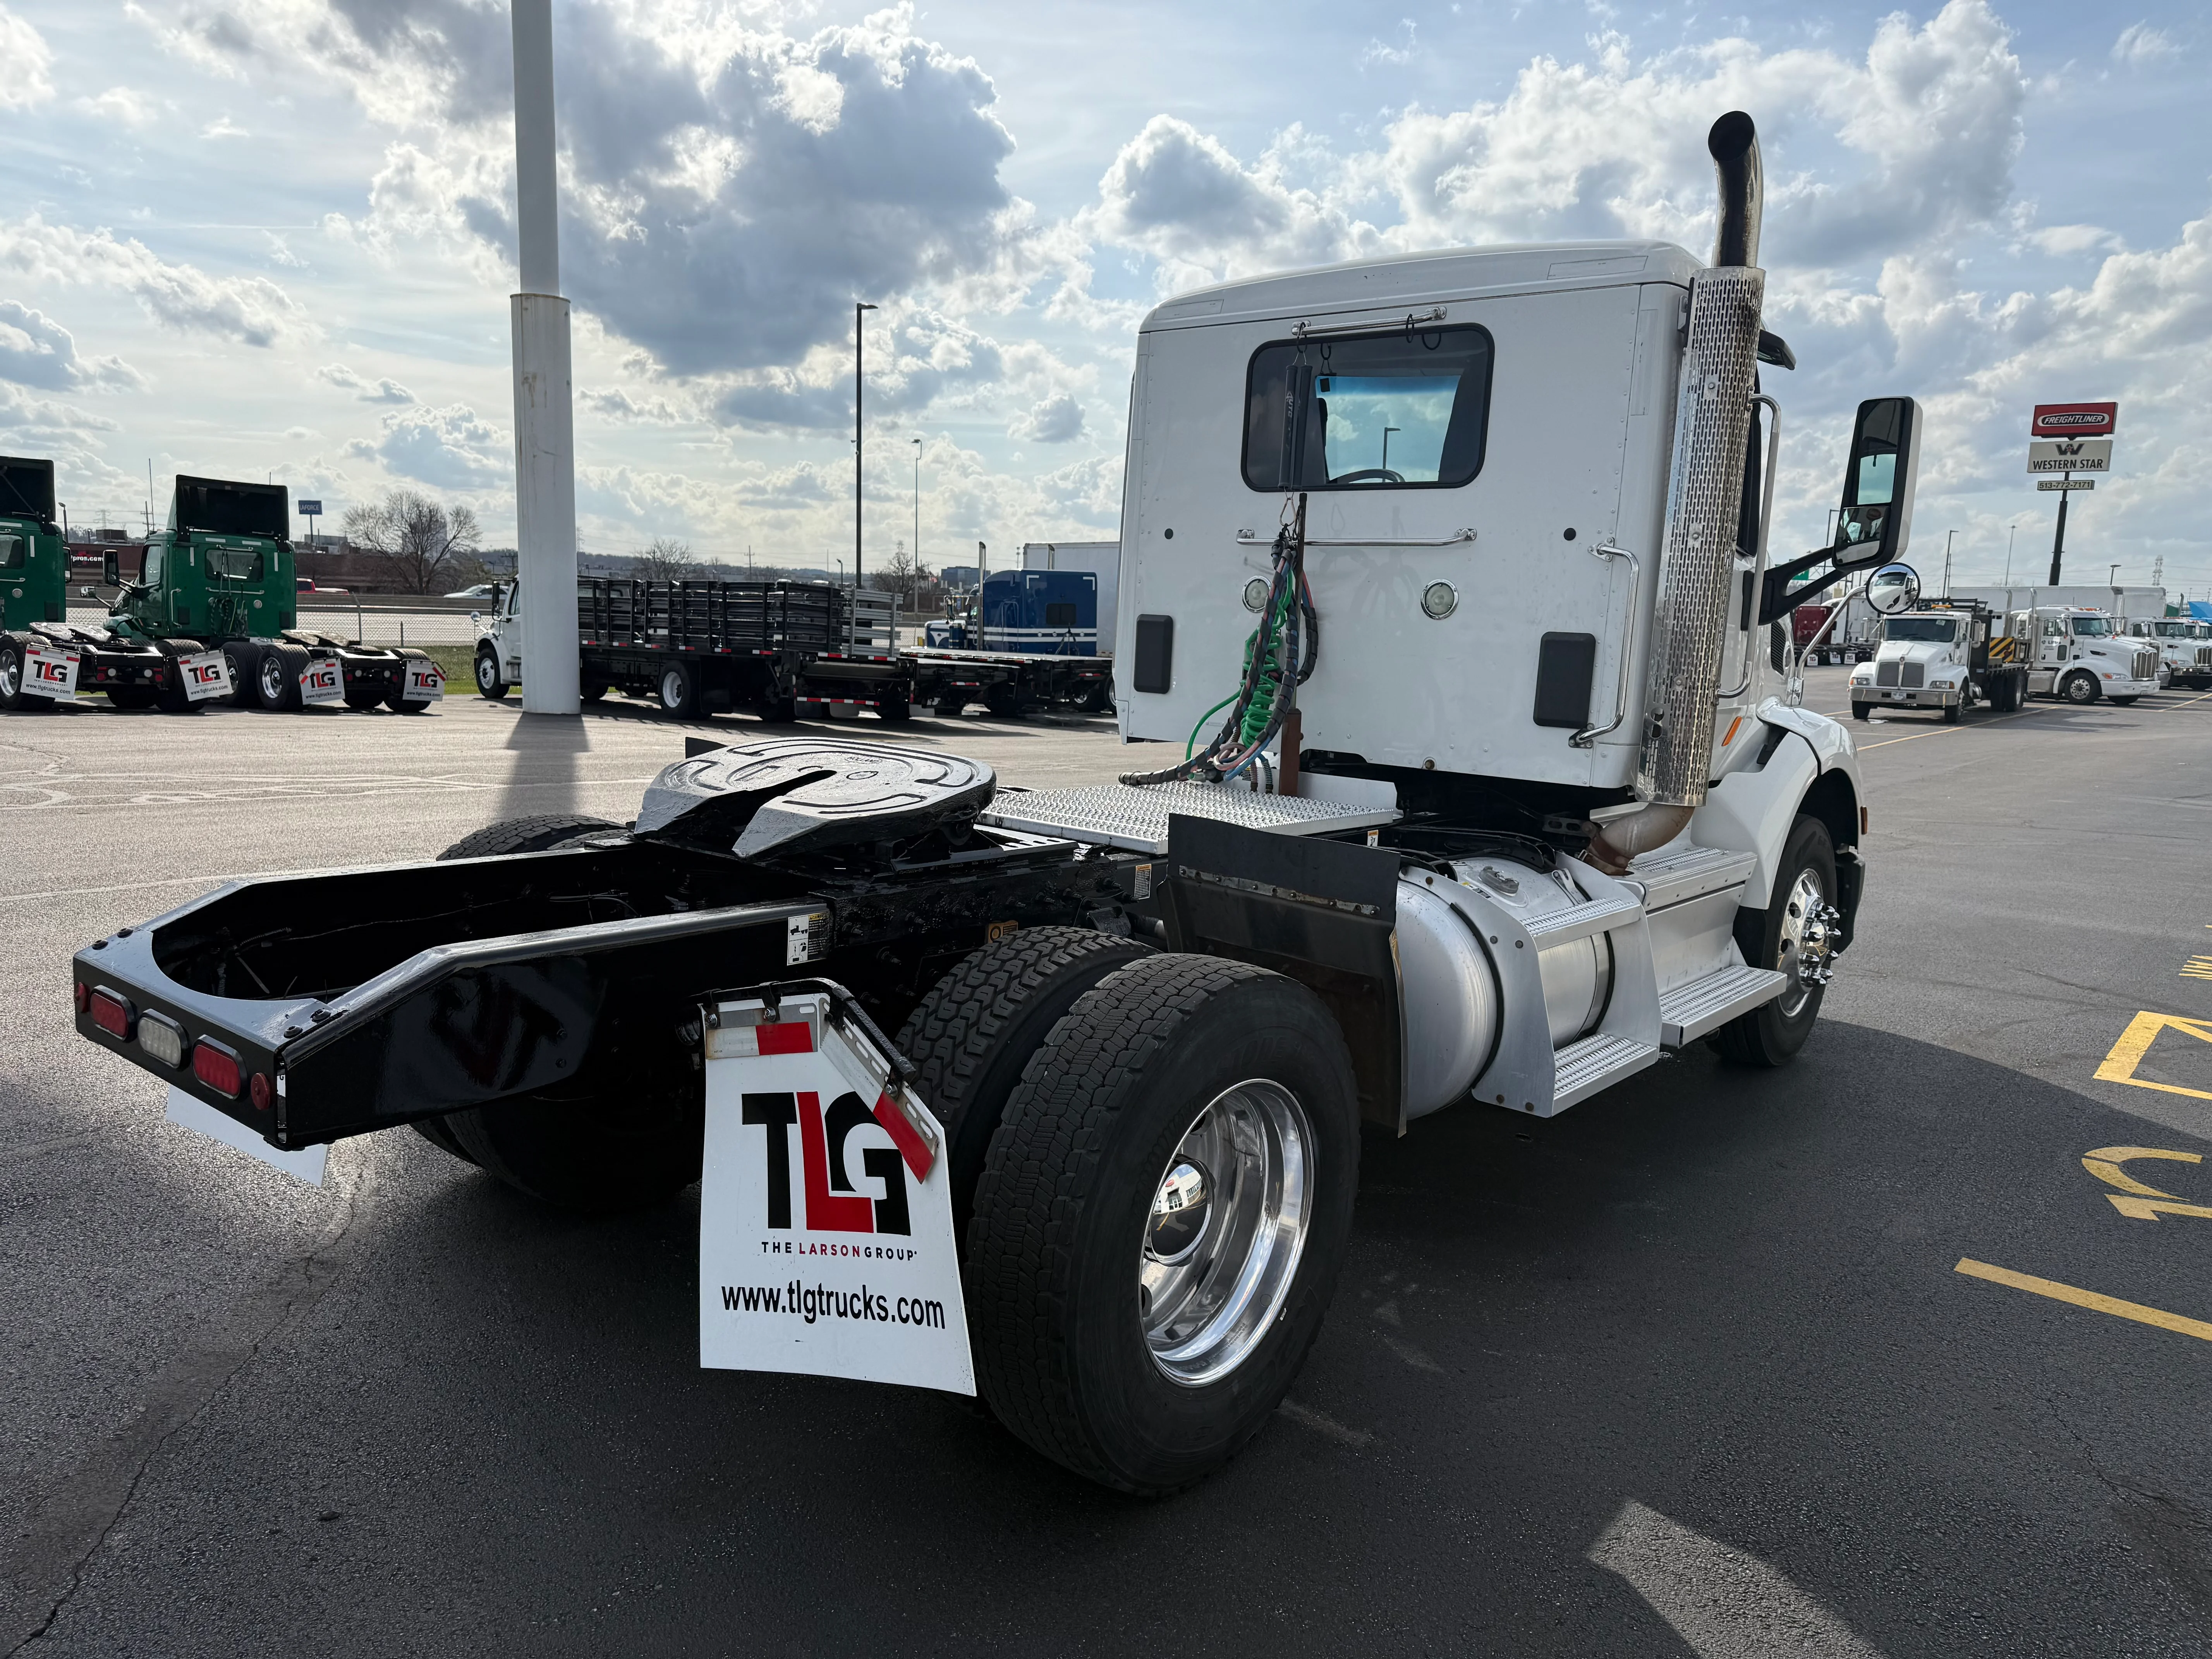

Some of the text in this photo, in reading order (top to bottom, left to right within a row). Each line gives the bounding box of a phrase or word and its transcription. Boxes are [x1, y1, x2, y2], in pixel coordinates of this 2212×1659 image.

[2044, 415, 2103, 424] FREIGHTLINER
[2033, 459, 2103, 470] WESTERN STAR
[33, 659, 68, 683] TLG
[188, 665, 221, 684] TLG
[309, 672, 336, 689] TLG
[412, 672, 438, 688] TLG
[26, 683, 70, 694] www.tlgtrucks.com
[191, 685, 228, 695] www.tlgtrucks.com
[742, 1091, 911, 1237] TLG
[761, 1242, 792, 1254] THE
[721, 1279, 946, 1329] www.tlgtrucks.com
